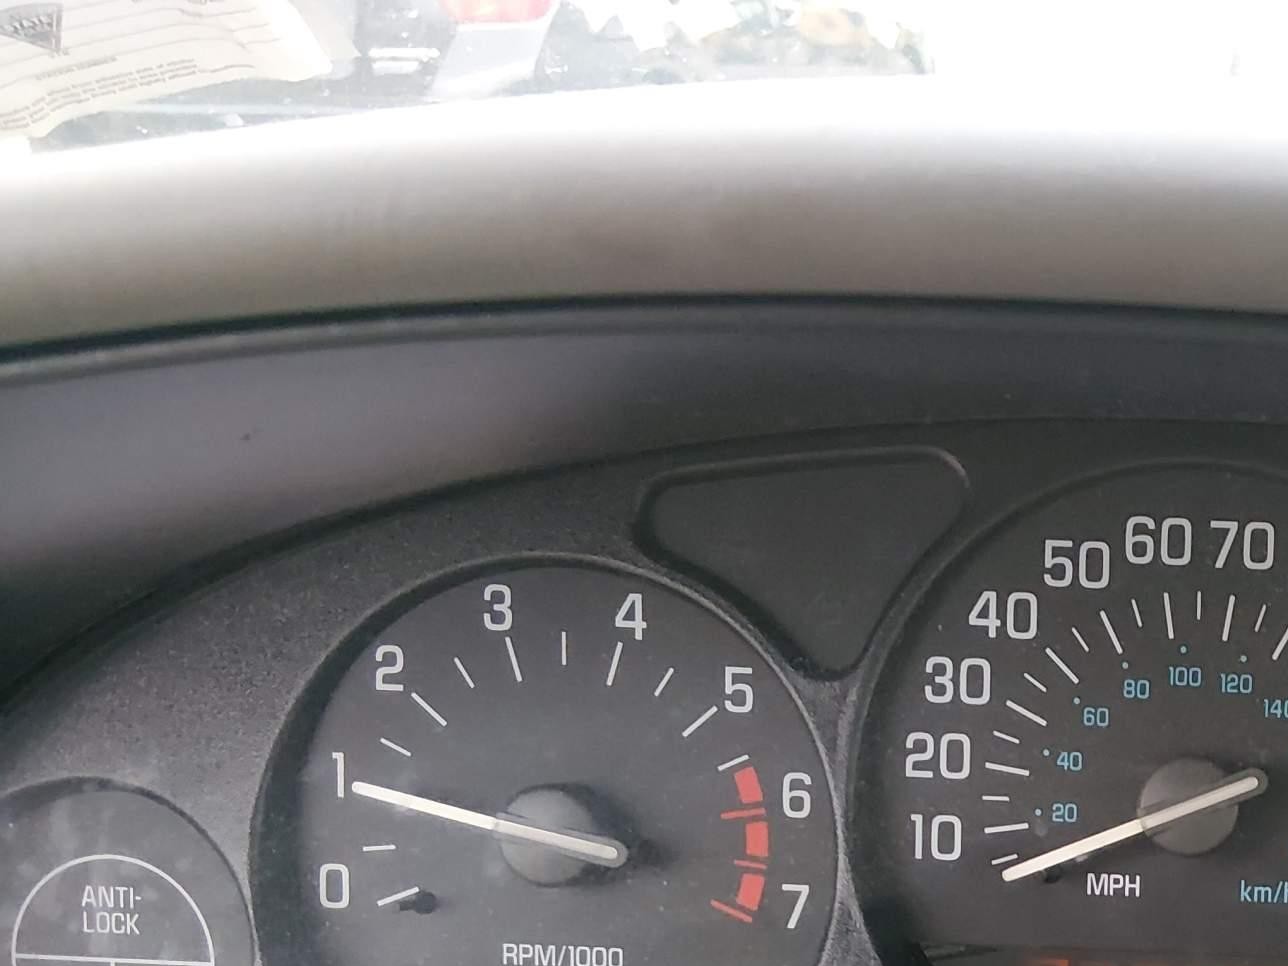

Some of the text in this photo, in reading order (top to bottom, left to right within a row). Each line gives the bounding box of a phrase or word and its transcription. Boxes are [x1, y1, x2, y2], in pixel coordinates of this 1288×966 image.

[1043, 539, 1111, 589] 50
[1125, 516, 1192, 566] 60
[1210, 520, 1276, 570] 70
[483, 584, 513, 631] 3
[615, 593, 647, 641] 4
[968, 591, 1039, 640] 40
[374, 646, 404, 691] 2
[723, 666, 755, 713] 5
[924, 656, 991, 705] 30
[1123, 679, 1150, 699] 80
[1168, 666, 1202, 687] 100
[1220, 673, 1253, 694] 120
[1083, 707, 1109, 728] 60
[332, 752, 345, 798] 1
[905, 731, 971, 780] 20
[1056, 751, 1083, 771] 40
[781, 772, 812, 817] 6
[1052, 803, 1077, 823] 20
[910, 813, 962, 862] 10
[81, 886, 141, 909] ANTI-
[319, 863, 350, 909] 0
[781, 883, 810, 929] 7
[1086, 873, 1142, 897] MPH
[83, 912, 140, 934] LOCK
